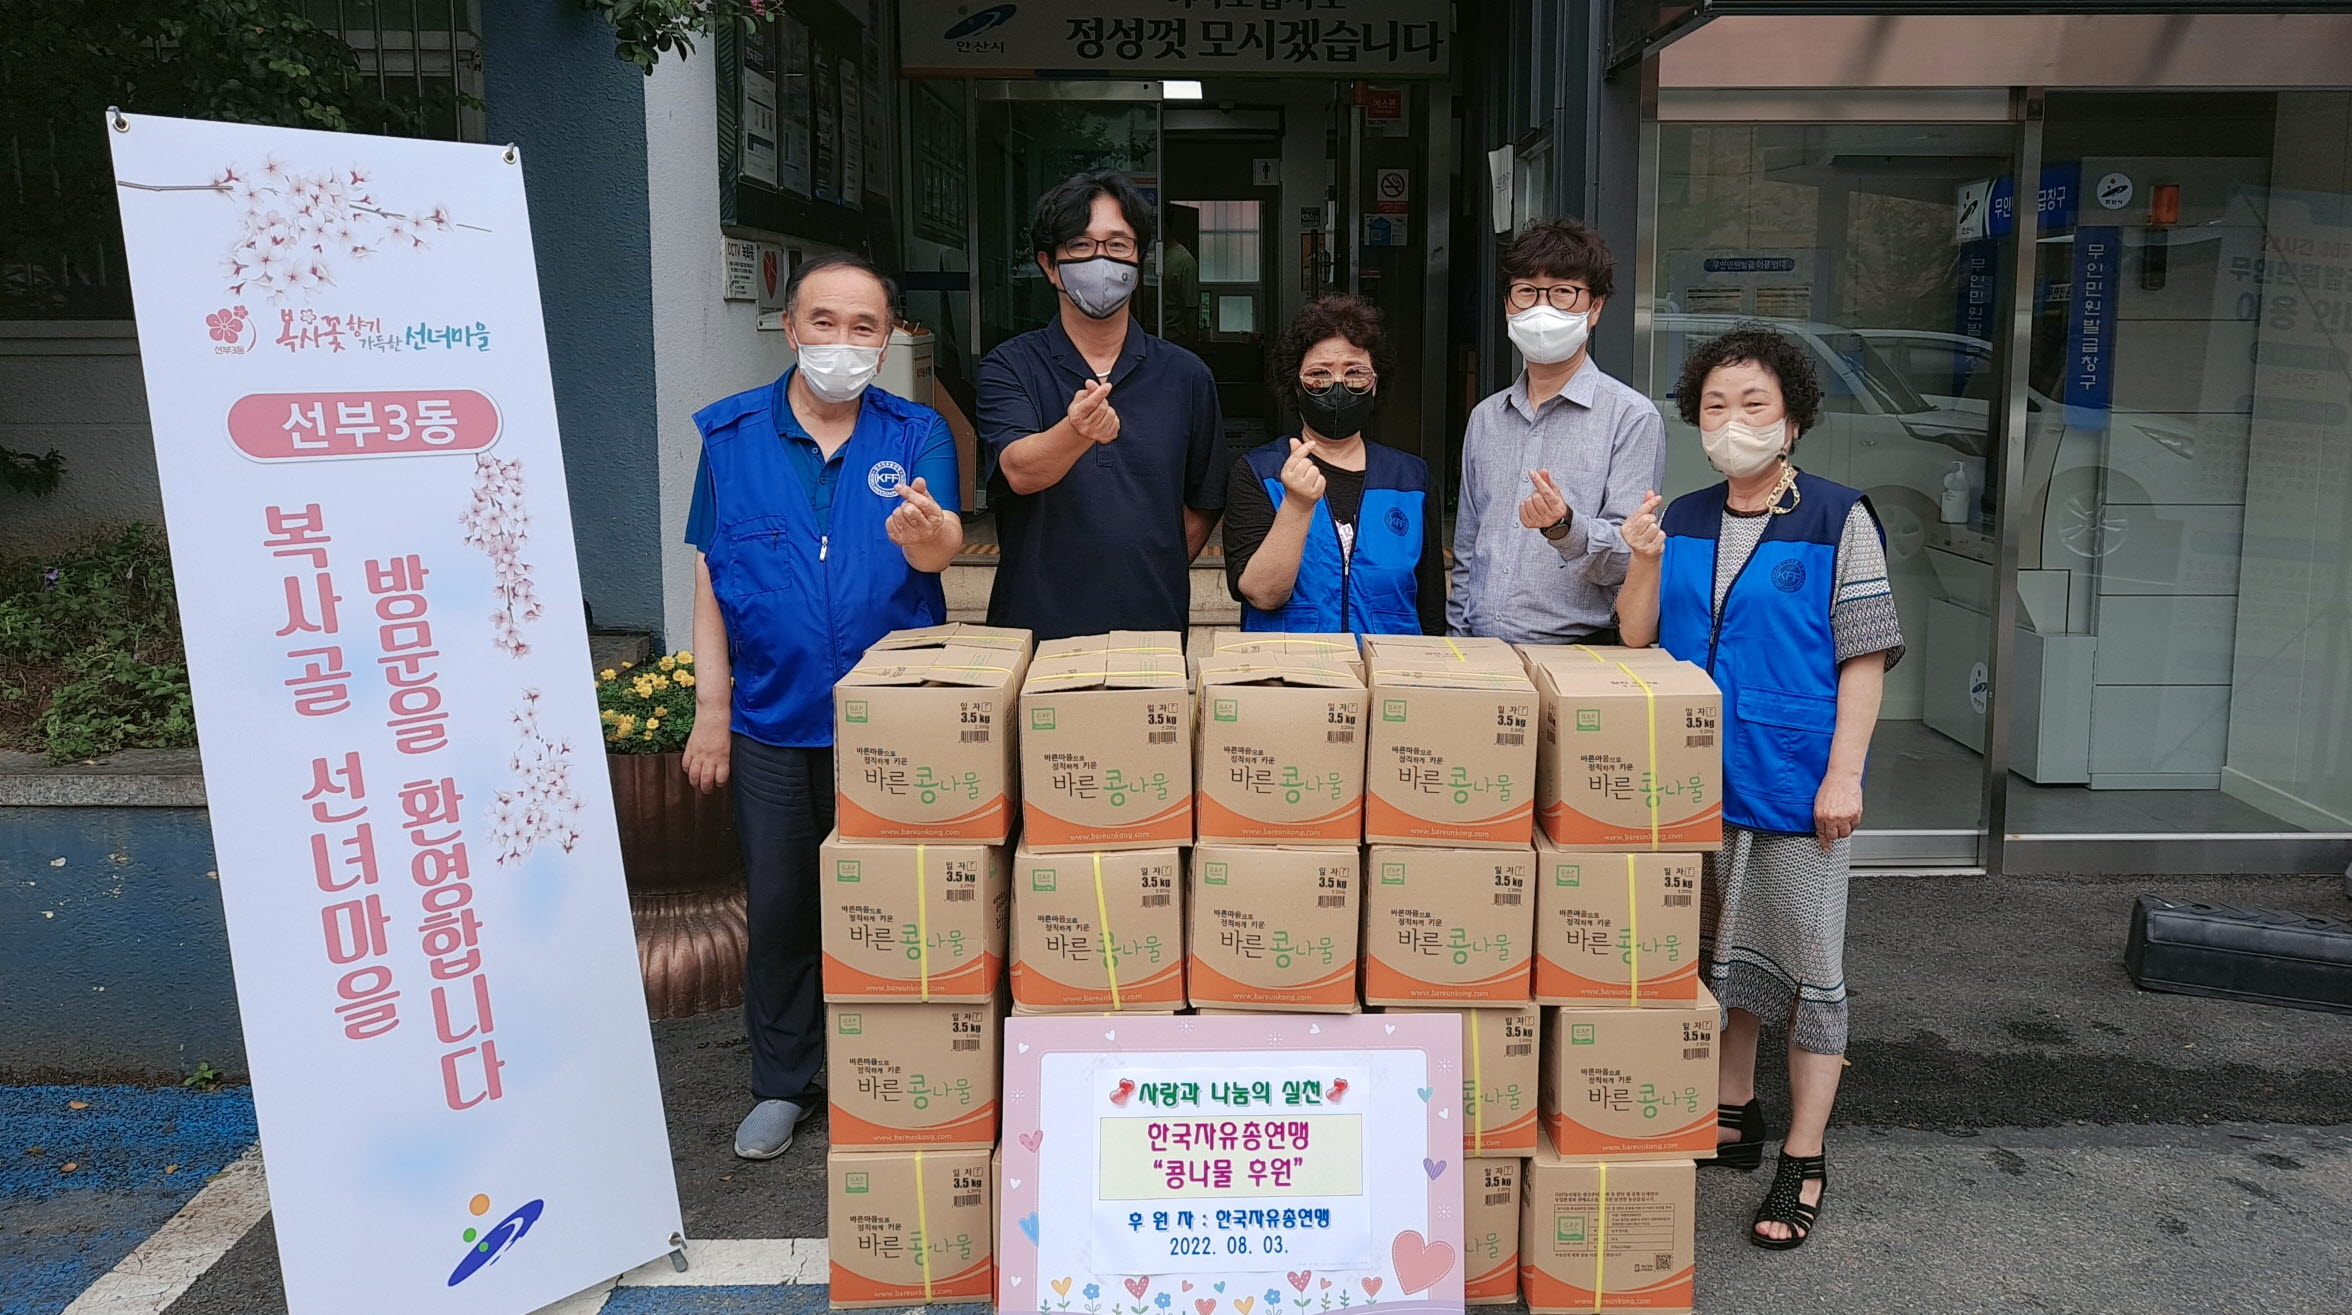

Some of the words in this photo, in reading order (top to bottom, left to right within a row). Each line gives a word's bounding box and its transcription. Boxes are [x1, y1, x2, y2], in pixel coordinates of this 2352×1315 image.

[956, 41, 1004, 53] 안산시
[1066, 17, 1186, 60] 정성껏
[1199, 18, 1444, 63] 모시겠습니다
[346, 314, 381, 337] 향기
[2079, 243, 2105, 390] 무인민원발급창구
[276, 309, 345, 352] 복사꽃
[359, 335, 402, 351] 가득한
[405, 321, 490, 351] 선녀마을
[282, 401, 458, 449] 선부3동
[876, 473, 899, 483] KFF
[1777, 570, 1801, 581] KFF
[263, 503, 351, 716] 복사골
[365, 554, 449, 754] 방문을
[961, 712, 977, 723] 3.5
[979, 713, 990, 724] kg
[1148, 714, 1164, 724] 3.5
[1166, 714, 1177, 725] kg
[1328, 713, 1344, 723] 3.5
[1345, 714, 1356, 725] kg
[1497, 715, 1514, 726] 3.5
[1515, 717, 1526, 727] kg
[1686, 717, 1702, 728] 3.5
[1704, 718, 1715, 729] kg
[864, 766, 910, 795] 바른
[914, 766, 981, 803] 콩나물
[1053, 771, 1099, 800] 바른
[1103, 768, 1170, 805] 콩나물
[1230, 765, 1276, 794] 바른
[1279, 766, 1344, 803] 콩나물
[1398, 765, 1444, 794] 바른
[1447, 767, 1513, 805] 콩나물
[1588, 773, 1635, 802] 바른
[1638, 771, 1705, 808] 콩나물
[946, 871, 963, 882] 3.5
[964, 872, 976, 883] kg
[1141, 876, 1158, 887] 3.5
[1160, 877, 1171, 888] kg
[1319, 877, 1335, 888] 3.5
[1336, 878, 1347, 889] kg
[1495, 875, 1511, 886] 3.5
[1512, 877, 1523, 887] kg
[1664, 877, 1681, 887] 3.5
[1682, 878, 1693, 888] kg
[302, 751, 400, 1041] 선녀마을
[397, 777, 506, 1111] 환영합니다
[849, 924, 896, 952] 바른
[899, 924, 966, 960] 콩나물
[1046, 933, 1092, 962] 바른
[1096, 931, 1162, 968] 콩나물
[1220, 929, 1266, 959] 바른
[1269, 930, 1335, 968] 콩나물
[1397, 927, 1443, 956] 바른
[1446, 928, 1511, 965] 콩나물
[1566, 928, 1612, 956] 바른
[1615, 928, 1682, 965] 콩나물
[1063, 994, 1142, 1002] www.bareunkg.com
[953, 1022, 969, 1032] 3.5
[970, 1023, 981, 1033] kg
[1506, 1026, 1521, 1037] 3.5
[1523, 1027, 1533, 1038] kg
[1683, 1031, 1699, 1041] 3.5
[1700, 1031, 1711, 1041] kg
[857, 1075, 903, 1103] 바른
[907, 1073, 972, 1109] 콩나물
[1139, 1083, 1200, 1106] 사랑과
[1211, 1081, 1270, 1105] 나눔의
[1282, 1080, 1321, 1104] 실천
[1588, 1085, 1633, 1113] 바른
[1636, 1082, 1700, 1118] 콩나물
[1148, 1121, 1308, 1151] 한국자유총연맹
[953, 1177, 969, 1188] 3.5
[971, 1178, 982, 1188] kg
[1485, 1176, 1500, 1187] 3.5
[1501, 1177, 1511, 1187] kg
[1216, 1209, 1330, 1229] 한국자유총연맹
[858, 1232, 904, 1260] 바른
[907, 1230, 972, 1265] 콩나물
[1170, 1237, 1216, 1255] 2022.
[1227, 1236, 1251, 1254] 08.
[1264, 1236, 1288, 1253] 03.
[1465, 1233, 1500, 1259] 나물
